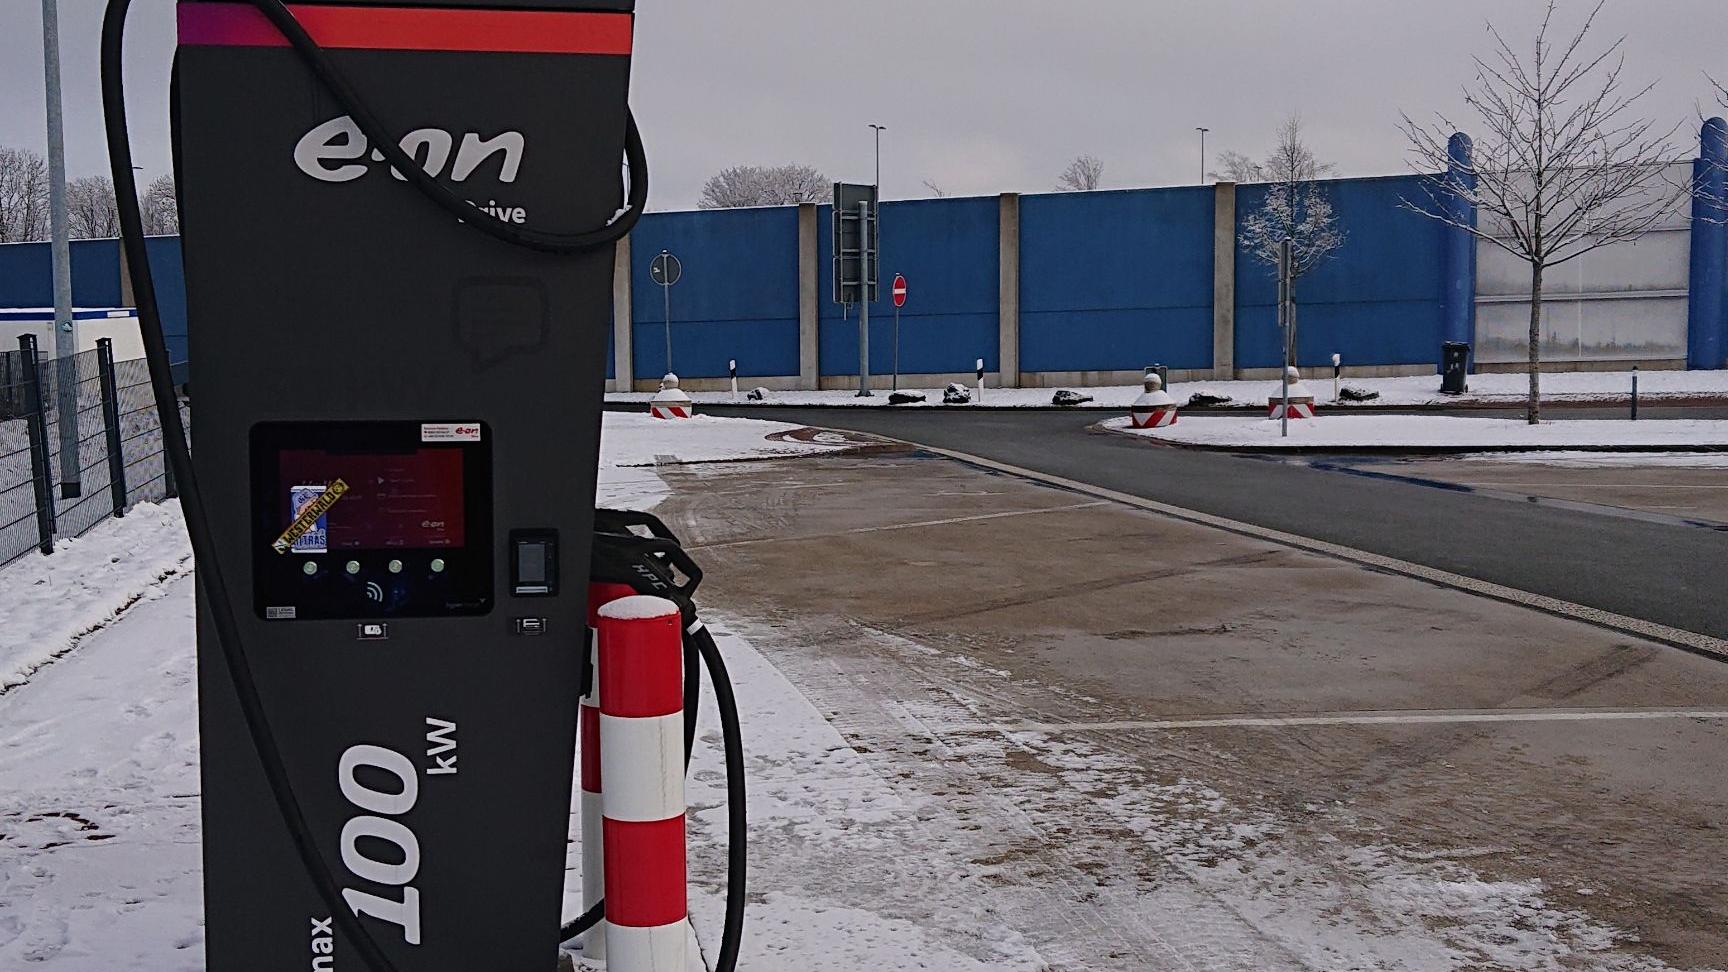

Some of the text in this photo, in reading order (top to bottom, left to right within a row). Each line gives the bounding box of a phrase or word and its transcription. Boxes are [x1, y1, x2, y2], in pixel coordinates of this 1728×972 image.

[458, 199, 526, 224] ive
[282, 492, 336, 544] WESTERWALD
[632, 564, 668, 590] HPC
[426, 717, 457, 775] kW
[338, 744, 421, 945] 100
